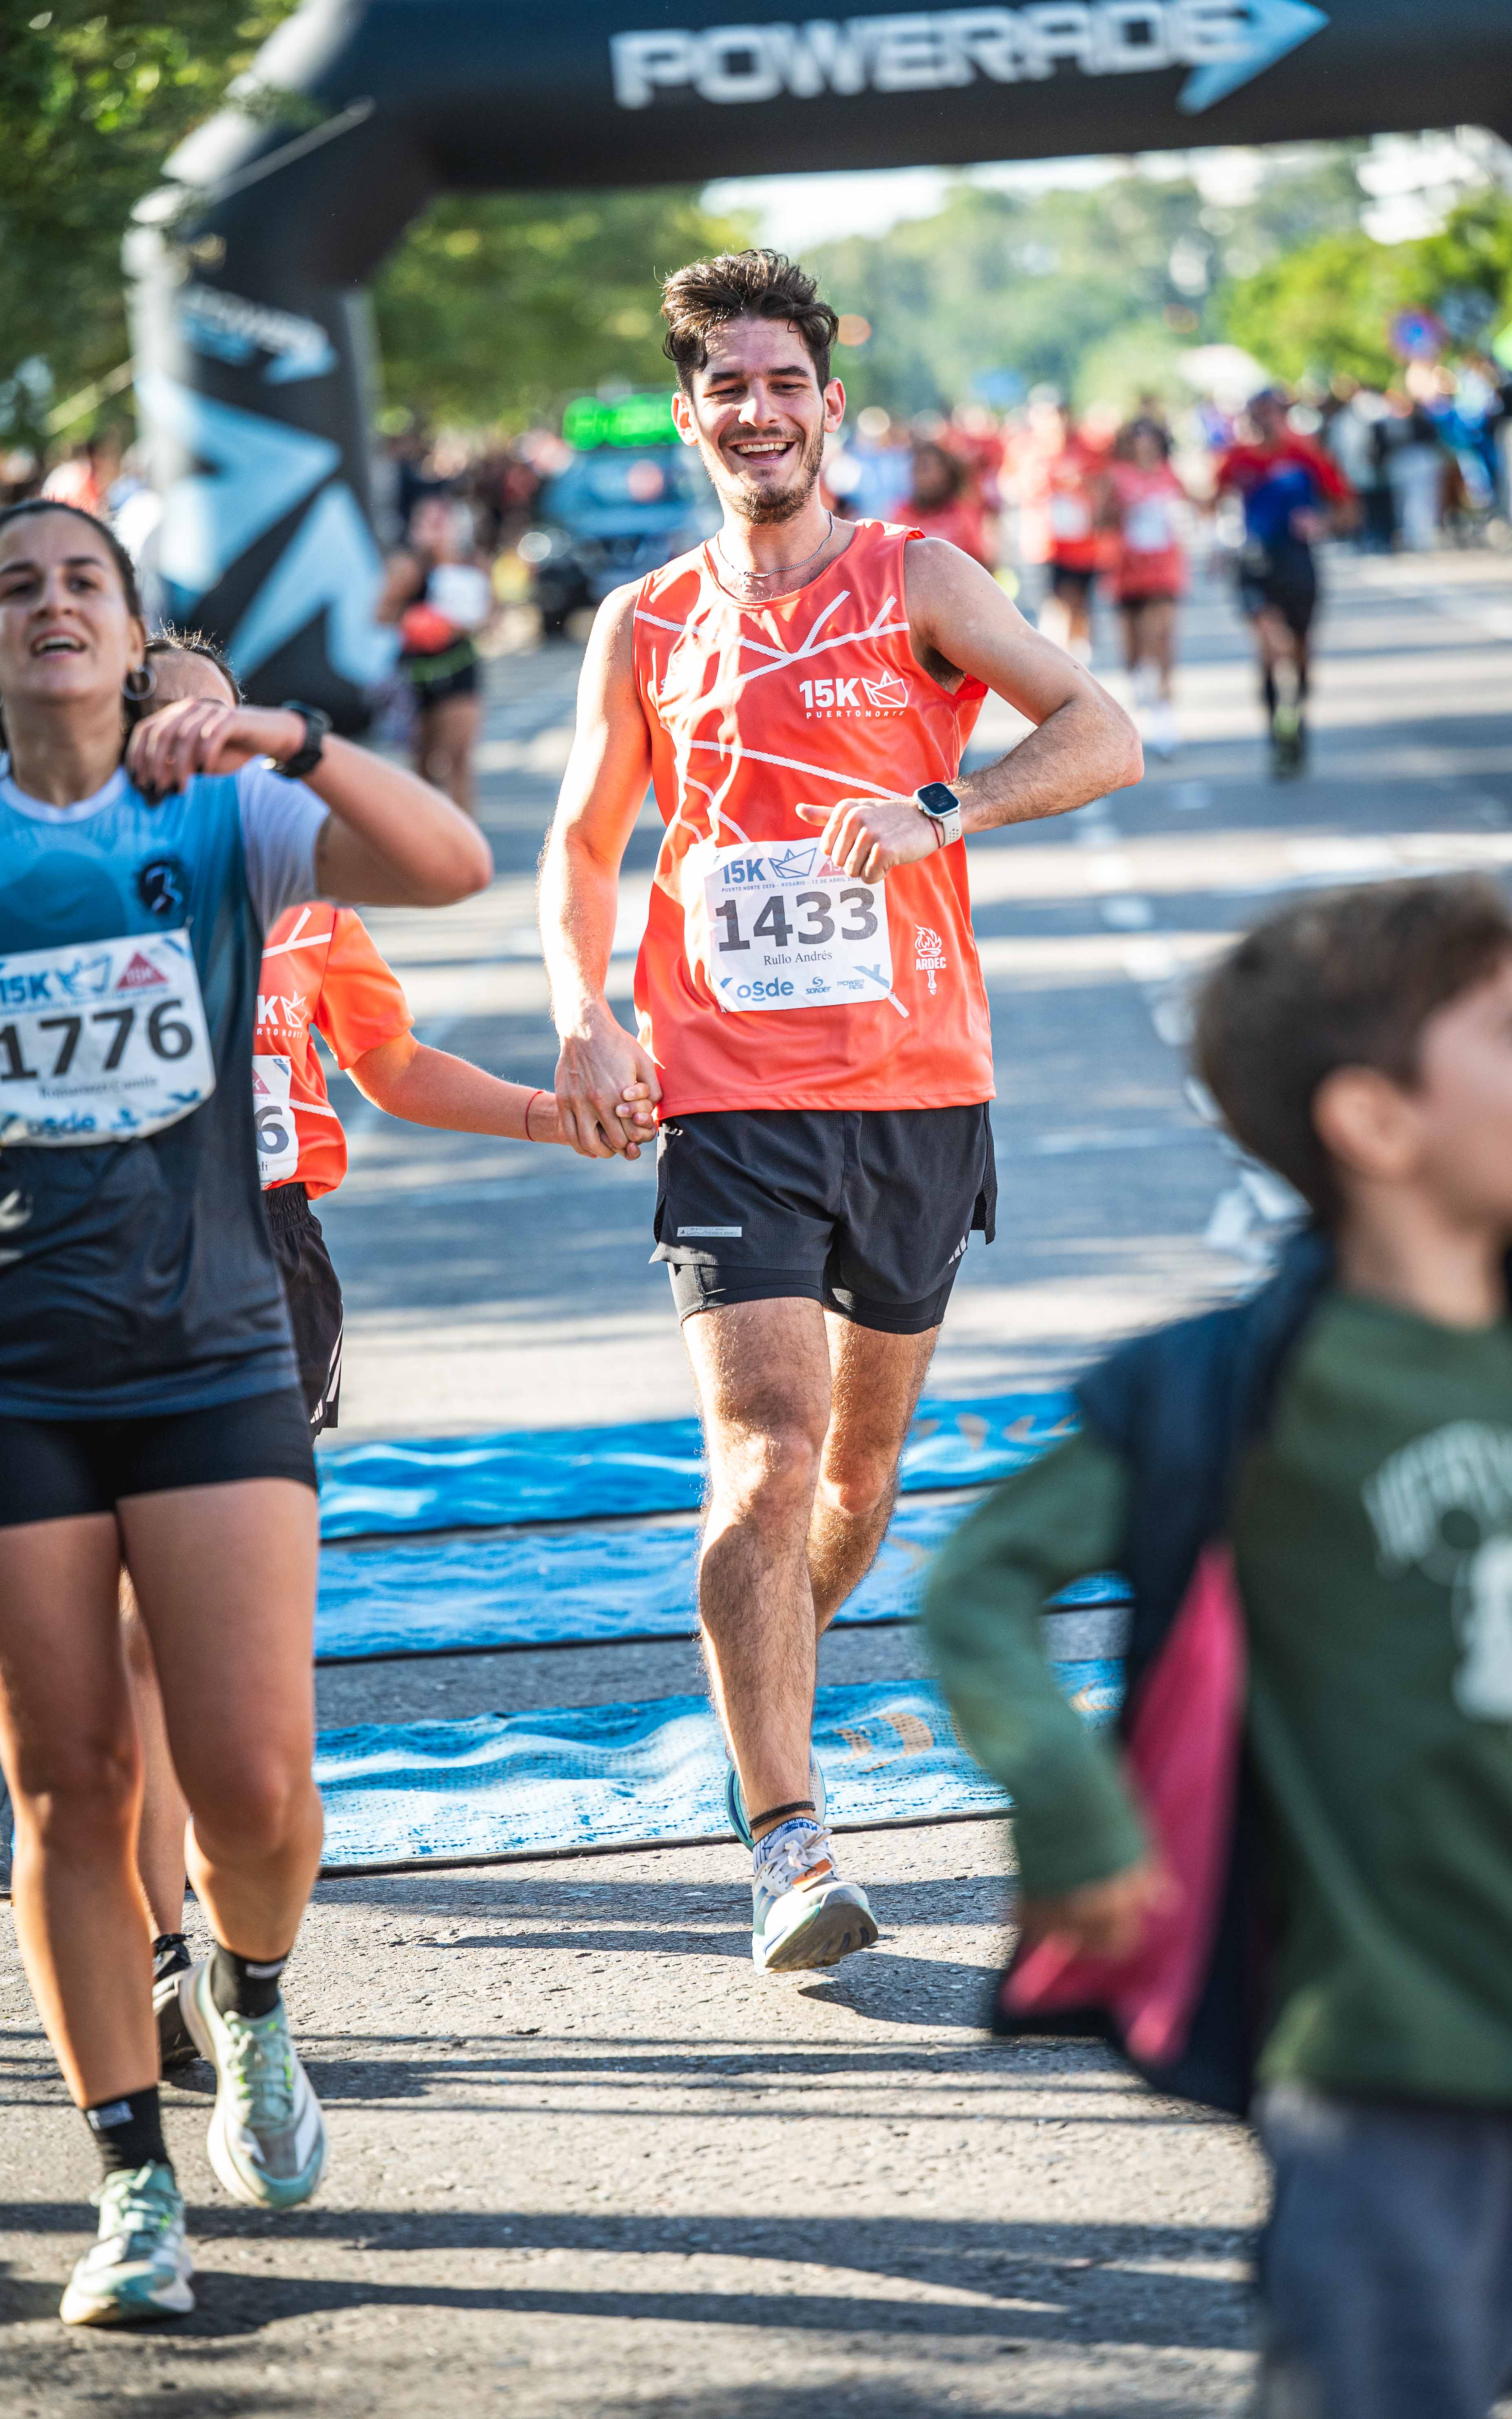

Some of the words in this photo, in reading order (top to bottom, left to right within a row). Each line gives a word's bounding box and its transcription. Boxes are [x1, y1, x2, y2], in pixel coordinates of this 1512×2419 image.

[608, 0, 1261, 109] POWERADE
[799, 678, 861, 708] 15K
[806, 711, 905, 719] PUERTONORTE
[720, 858, 766, 884] 15K
[715, 887, 878, 952] 1433
[764, 954, 791, 966] Rullo
[795, 950, 833, 963] Andrés
[916, 957, 946, 971] ARDEC
[737, 977, 794, 999] osde
[257, 995, 279, 1025] K
[0, 999, 193, 1081] 1776
[257, 1028, 303, 1038] RTONORTE
[255, 1106, 289, 1154] 6
